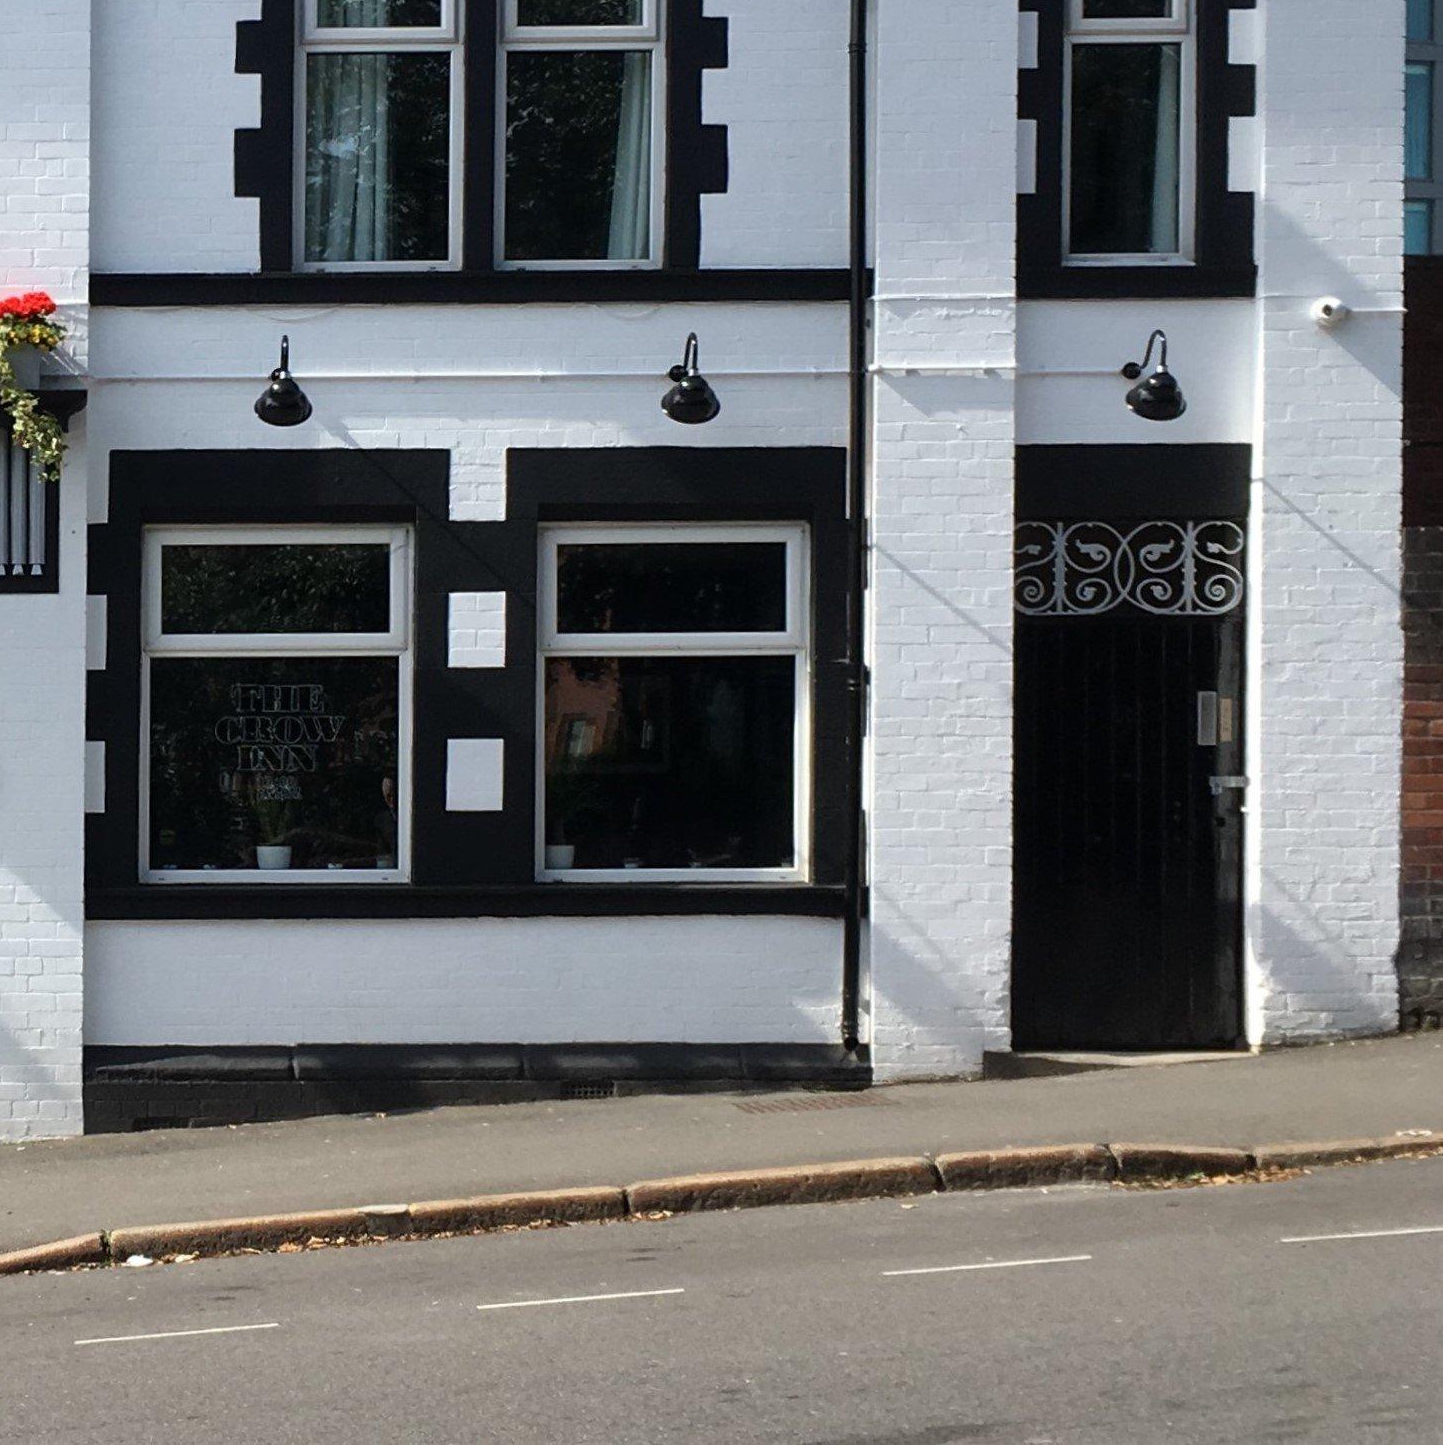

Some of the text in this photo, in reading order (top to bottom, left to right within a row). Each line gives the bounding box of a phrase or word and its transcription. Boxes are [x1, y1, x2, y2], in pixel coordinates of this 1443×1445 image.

[231, 683, 325, 712] THE
[214, 716, 346, 744] CROW
[237, 745, 319, 772] INN
